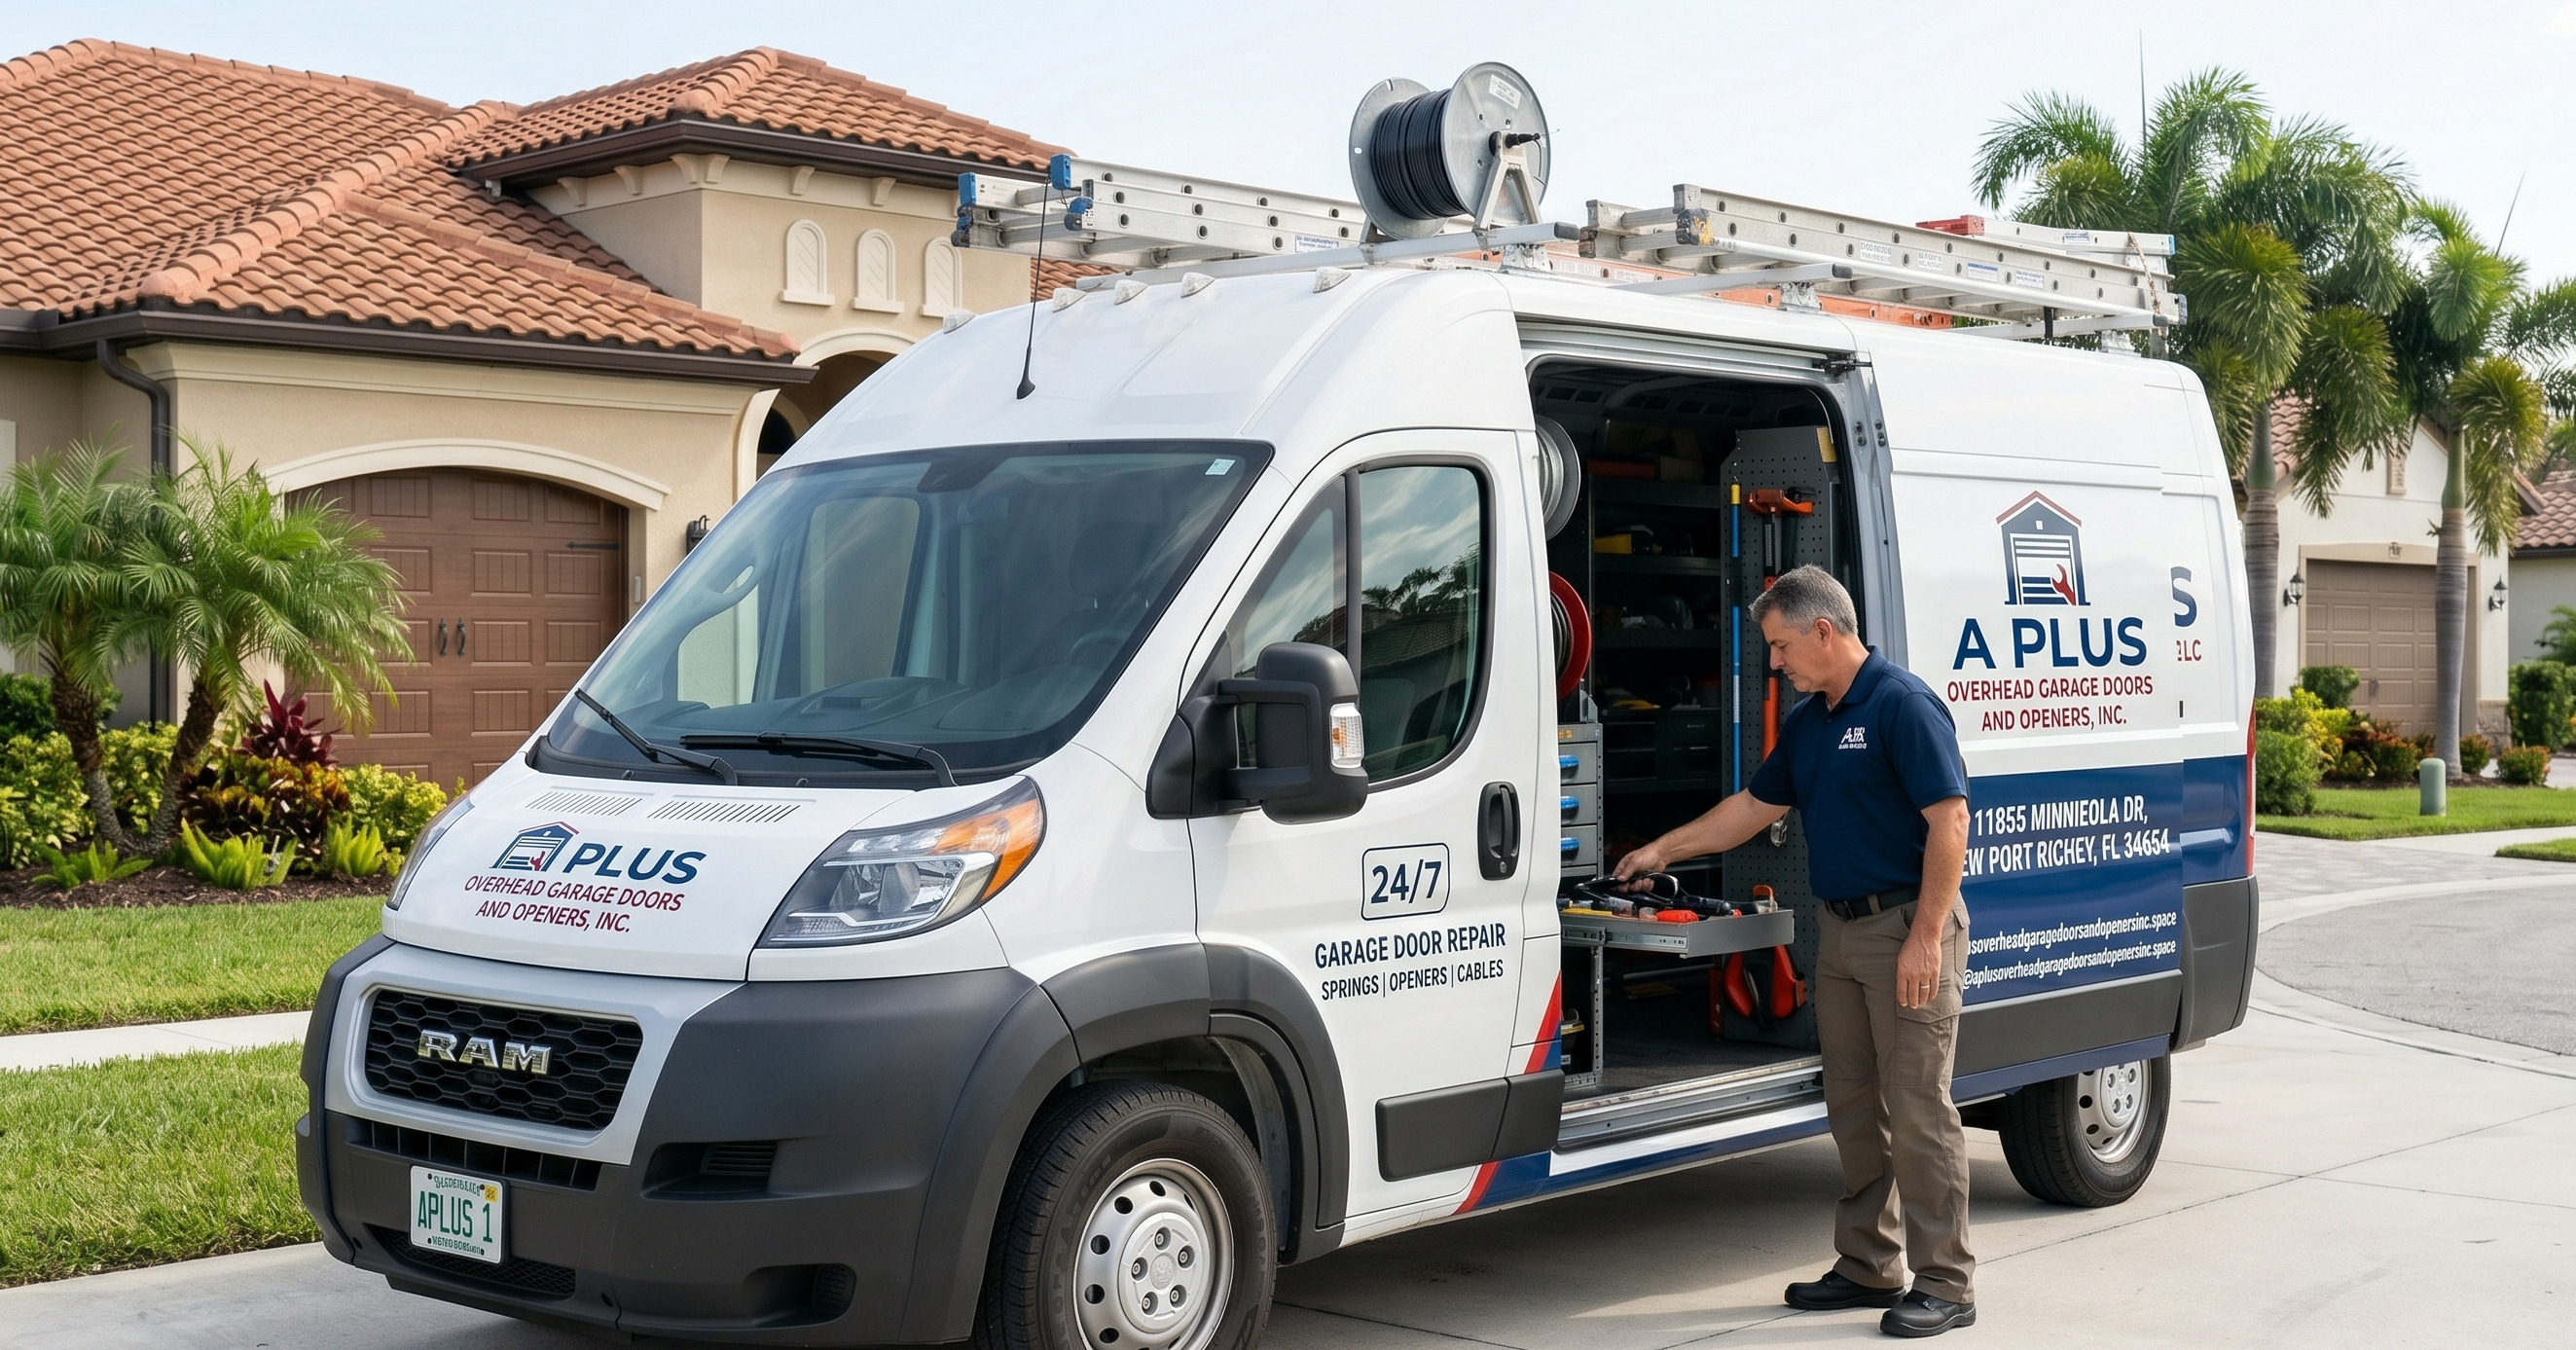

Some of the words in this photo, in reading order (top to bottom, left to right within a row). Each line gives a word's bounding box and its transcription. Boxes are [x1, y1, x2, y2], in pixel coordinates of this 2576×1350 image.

[1952, 618, 1997, 671] A
[2012, 616, 2147, 669] PLUS
[1947, 678, 2034, 703] OVERHEAD
[2039, 676, 2099, 700] GARAGE
[2103, 675, 2154, 696] DOORS
[1981, 710, 2015, 732] AND
[2019, 707, 2094, 731] OPENERS,
[2098, 705, 2127, 725] INC.
[1975, 804, 2027, 837] 11855
[2030, 797, 2120, 831] MINNIEOLA
[2123, 794, 2149, 824] DR,
[562, 842, 707, 885] PLUS
[1989, 842, 2034, 874] PORT
[2037, 835, 2098, 868] RICHEY,
[2102, 833, 2122, 861] FL
[2123, 827, 2170, 858] 34654
[464, 875, 546, 896] OVERHEAD
[547, 881, 618, 904] GARAGE
[617, 889, 685, 912] DOORS
[1370, 858, 1442, 905] 24/7
[476, 900, 512, 919] AND
[512, 903, 591, 931] OPENERS,
[595, 911, 631, 932] INC.
[1314, 935, 1389, 969] GARAGE
[1394, 930, 1442, 960] DOOR
[1447, 923, 1506, 953] REPAIR
[1322, 974, 1380, 1001] SPRINGS
[1390, 966, 1448, 993] OPENERS
[1457, 959, 1504, 983] CABLES
[417, 1029, 552, 1076] RAM
[417, 1190, 473, 1238] APLUS
[483, 1202, 493, 1244] 1
